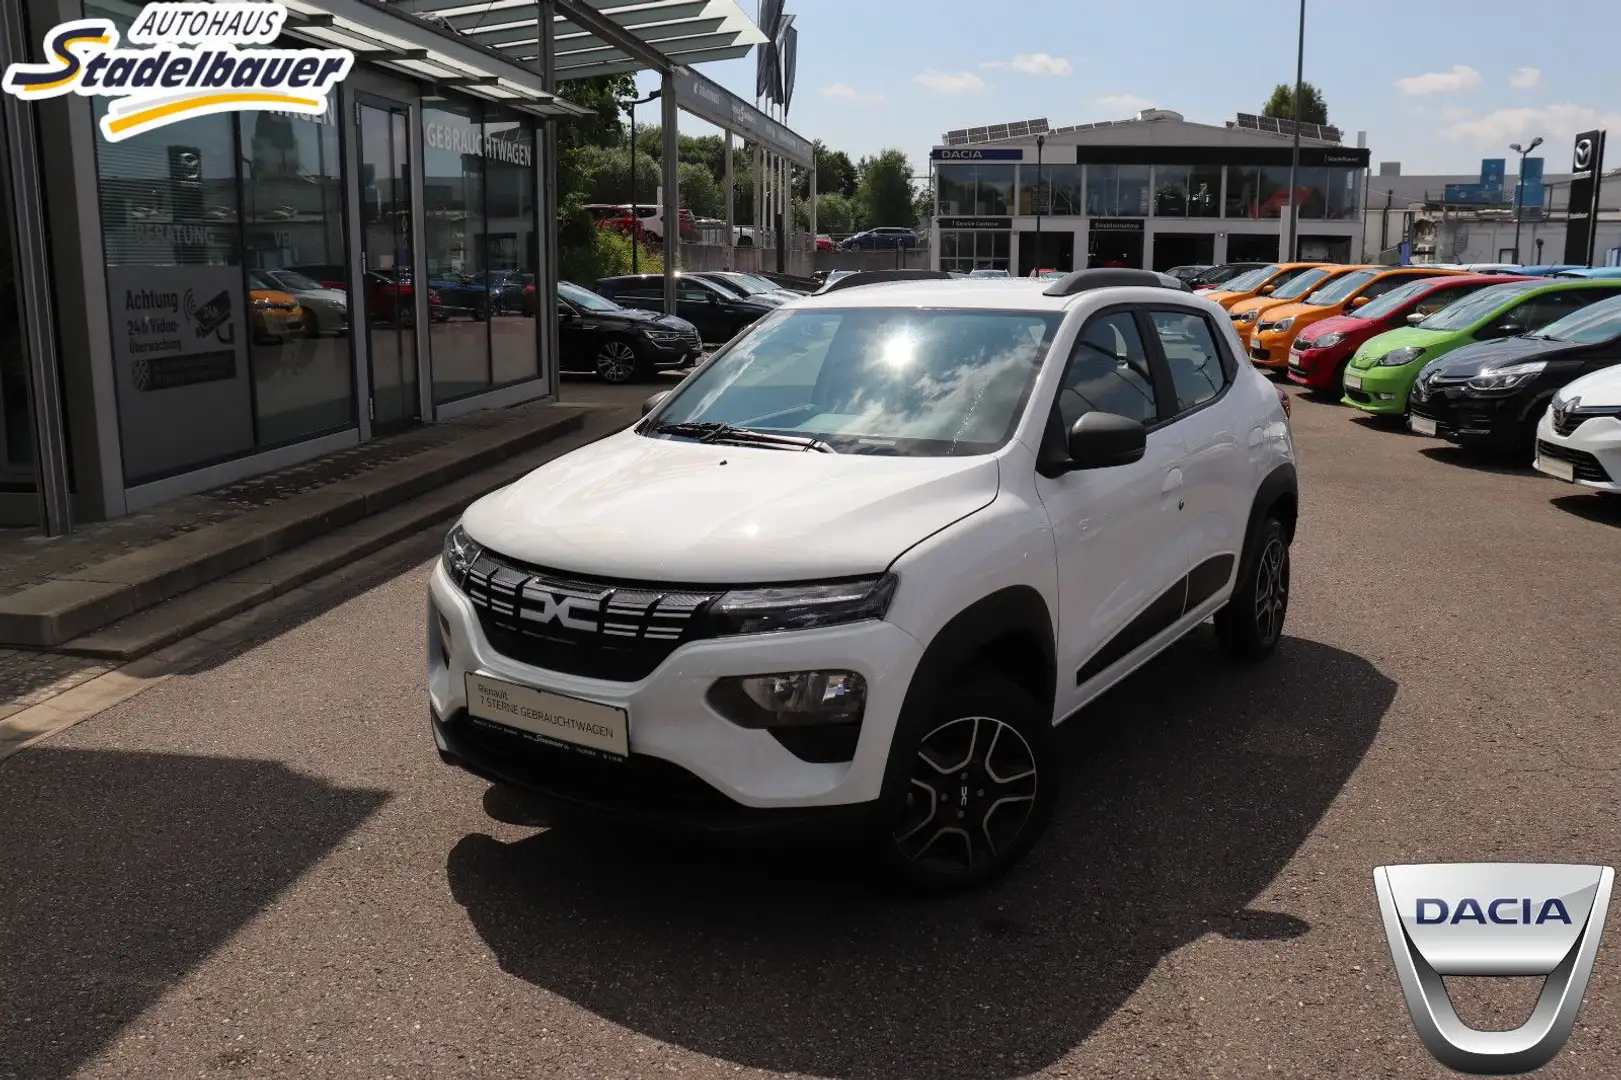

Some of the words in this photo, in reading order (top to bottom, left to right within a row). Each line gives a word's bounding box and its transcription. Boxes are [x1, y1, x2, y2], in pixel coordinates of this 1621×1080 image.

[426, 123, 532, 167] GEBRAUCHTWAGEN
[941, 150, 983, 159] DACIA
[126, 289, 179, 313] Achtung
[478, 683, 509, 701] Renault
[480, 695, 486, 705] 7
[487, 697, 520, 715] STERNE
[519, 706, 615, 739] GEBRAUCHTWAGEN
